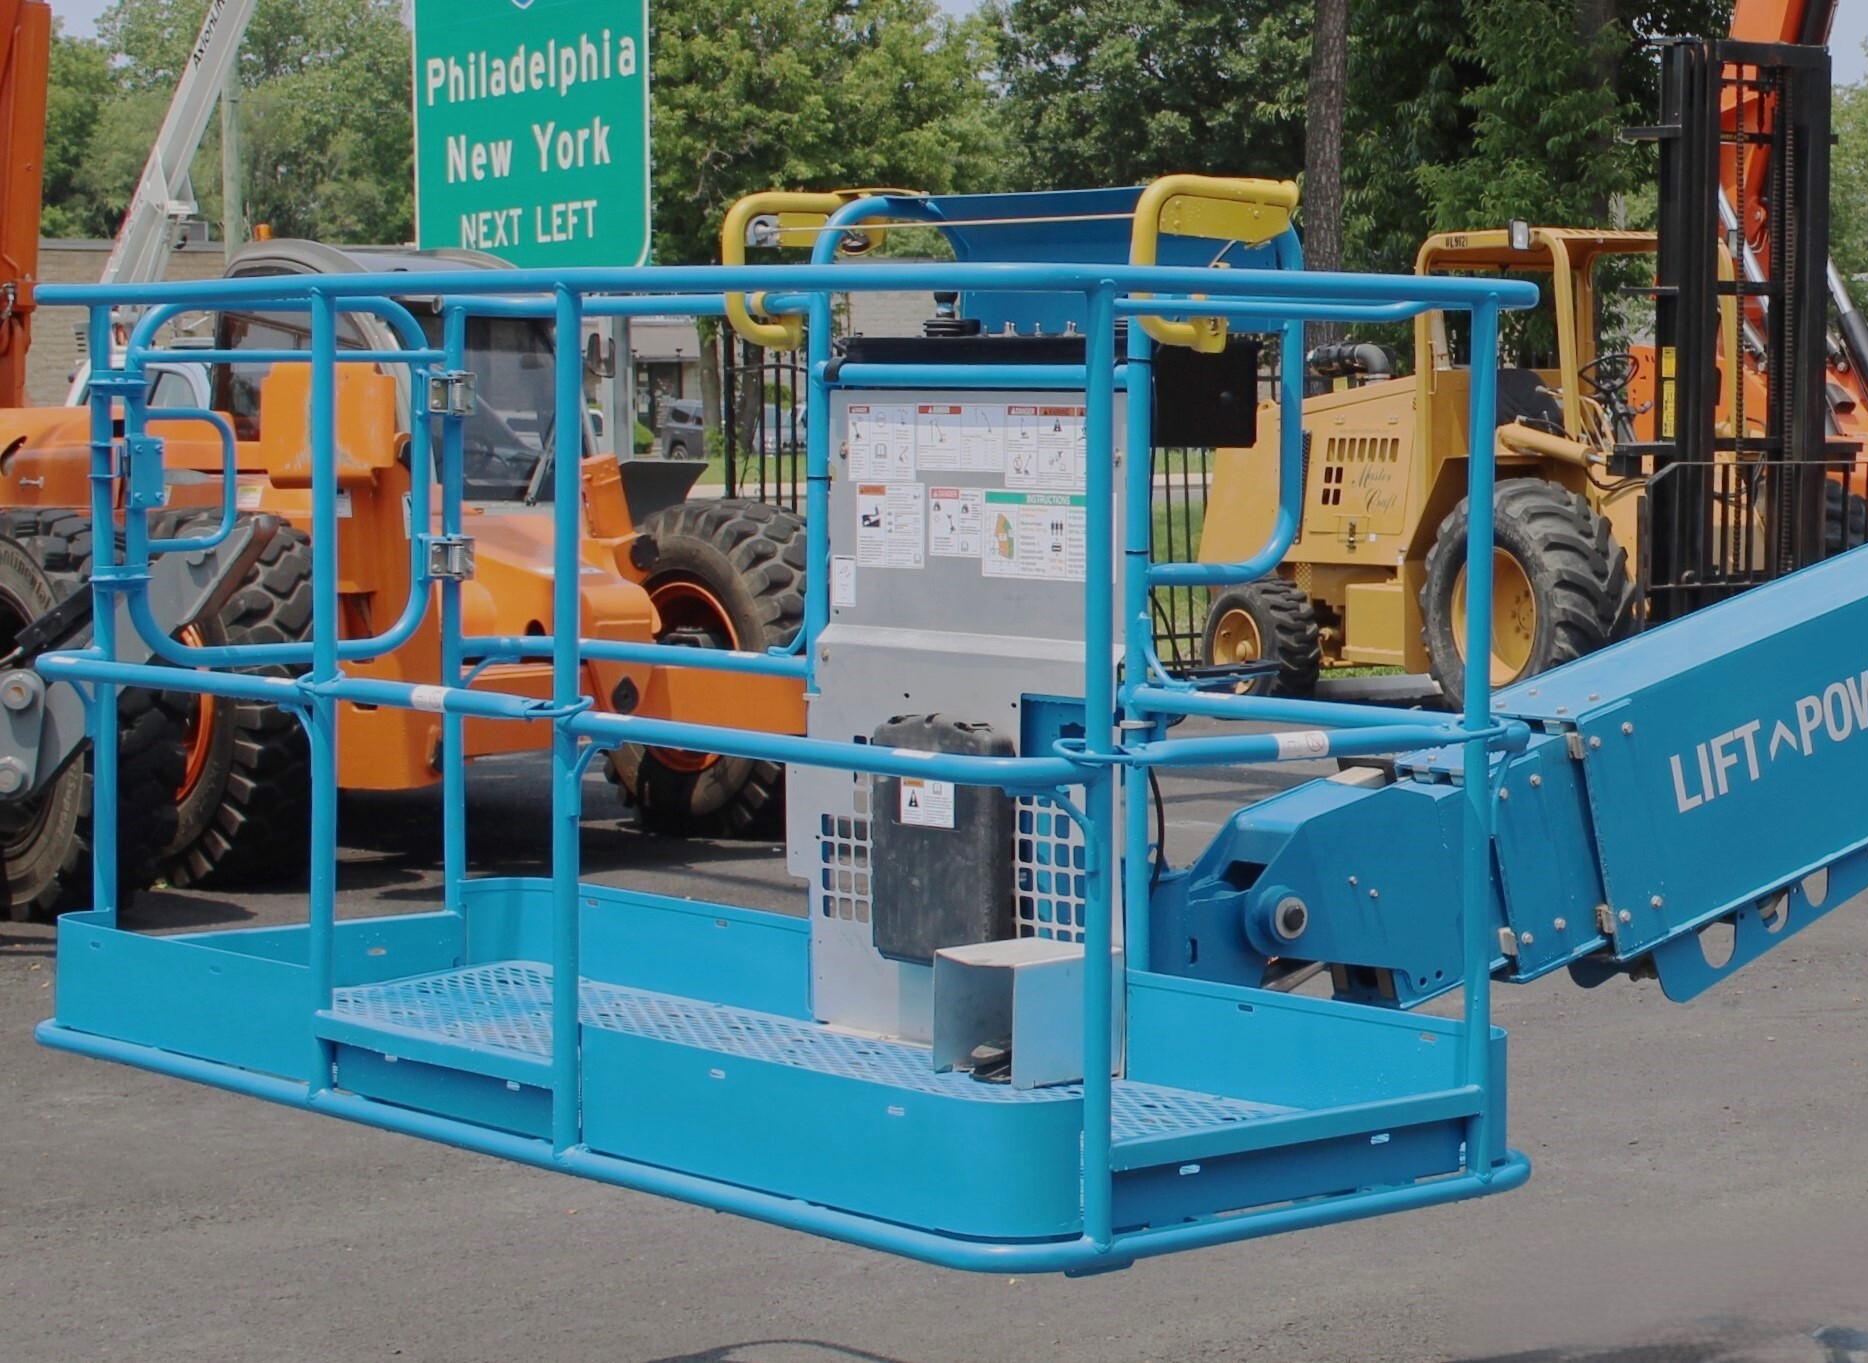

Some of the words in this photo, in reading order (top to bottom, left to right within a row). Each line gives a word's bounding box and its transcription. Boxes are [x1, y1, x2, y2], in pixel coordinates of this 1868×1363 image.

[427, 28, 636, 106] Philadelphia
[447, 134, 513, 184] New
[532, 116, 611, 173] York
[461, 208, 523, 250] NEXT
[536, 199, 598, 243] LEFT
[1670, 719, 1761, 814] LIFT
